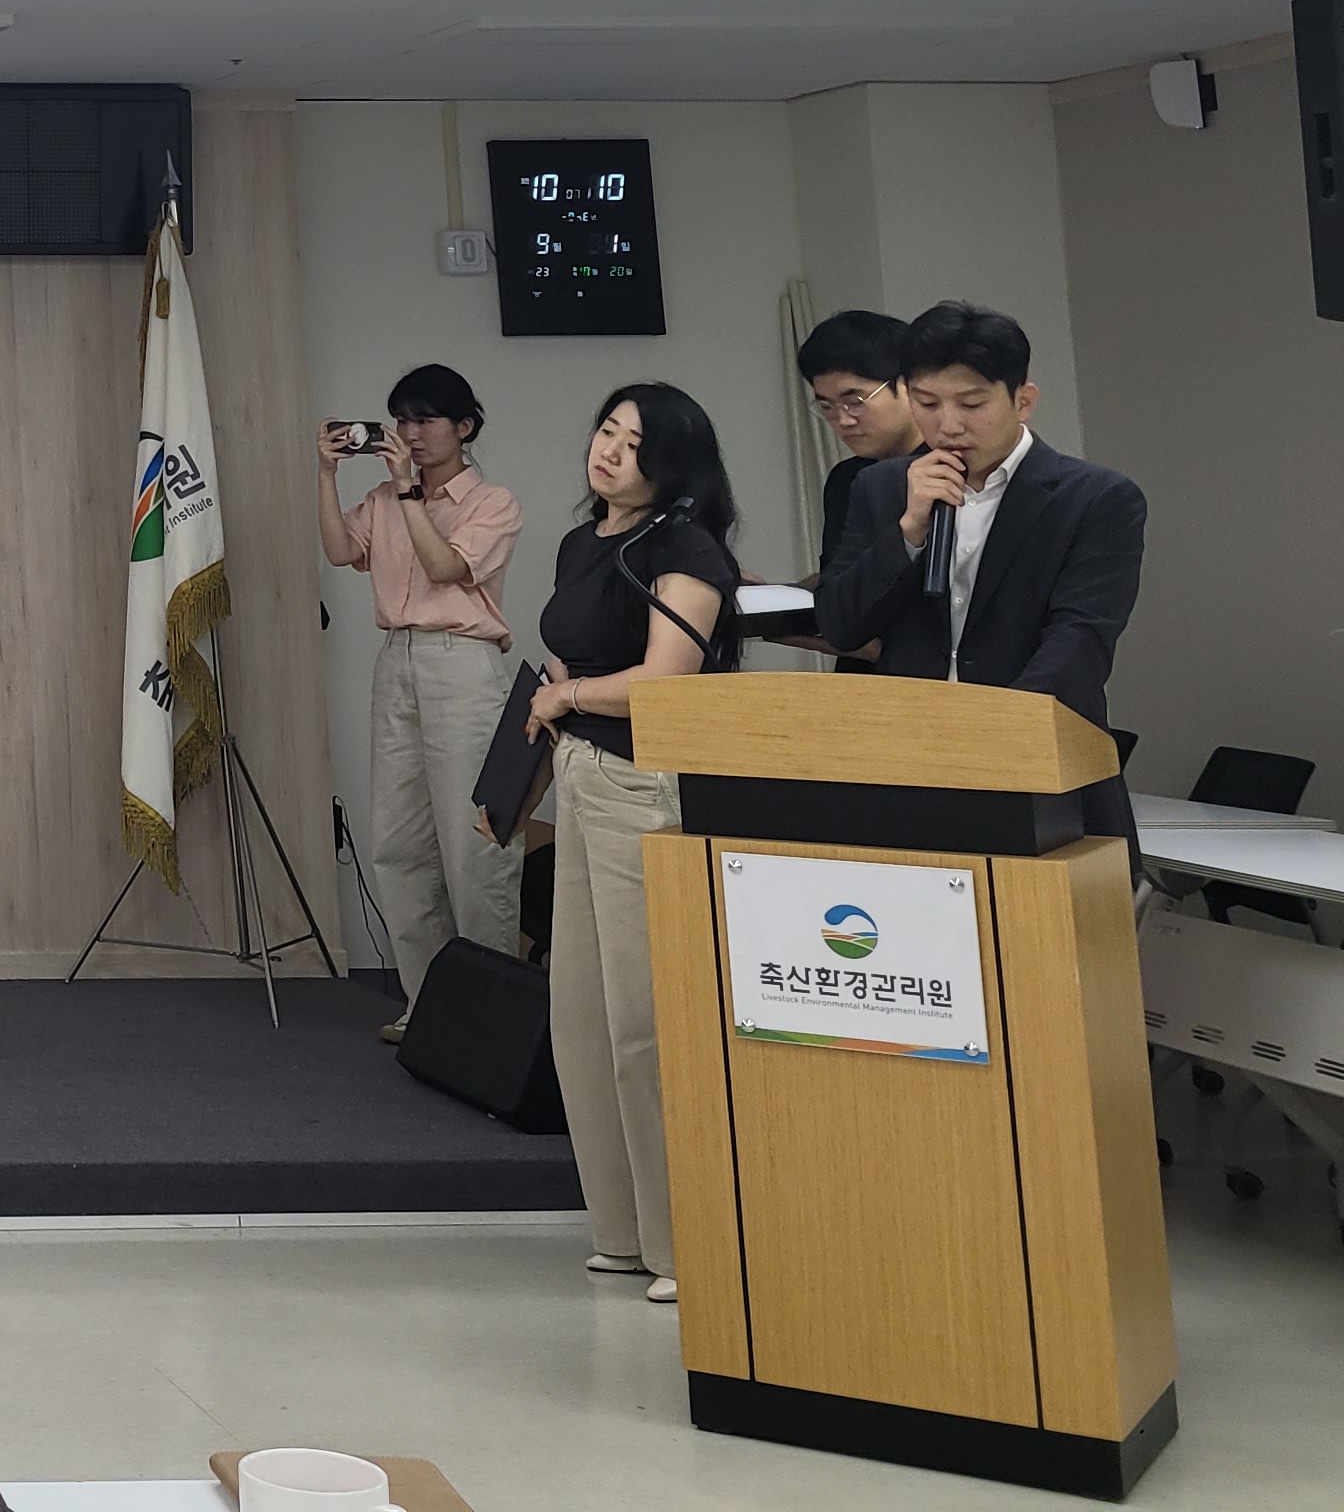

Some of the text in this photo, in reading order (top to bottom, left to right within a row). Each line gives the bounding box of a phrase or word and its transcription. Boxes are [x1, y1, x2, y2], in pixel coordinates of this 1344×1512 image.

[163, 444, 206, 510] 원
[169, 497, 214, 529] Institute
[760, 962, 953, 1008] 축산환경관리원
[762, 993, 953, 1020] Livestock Environmental Management Institute
